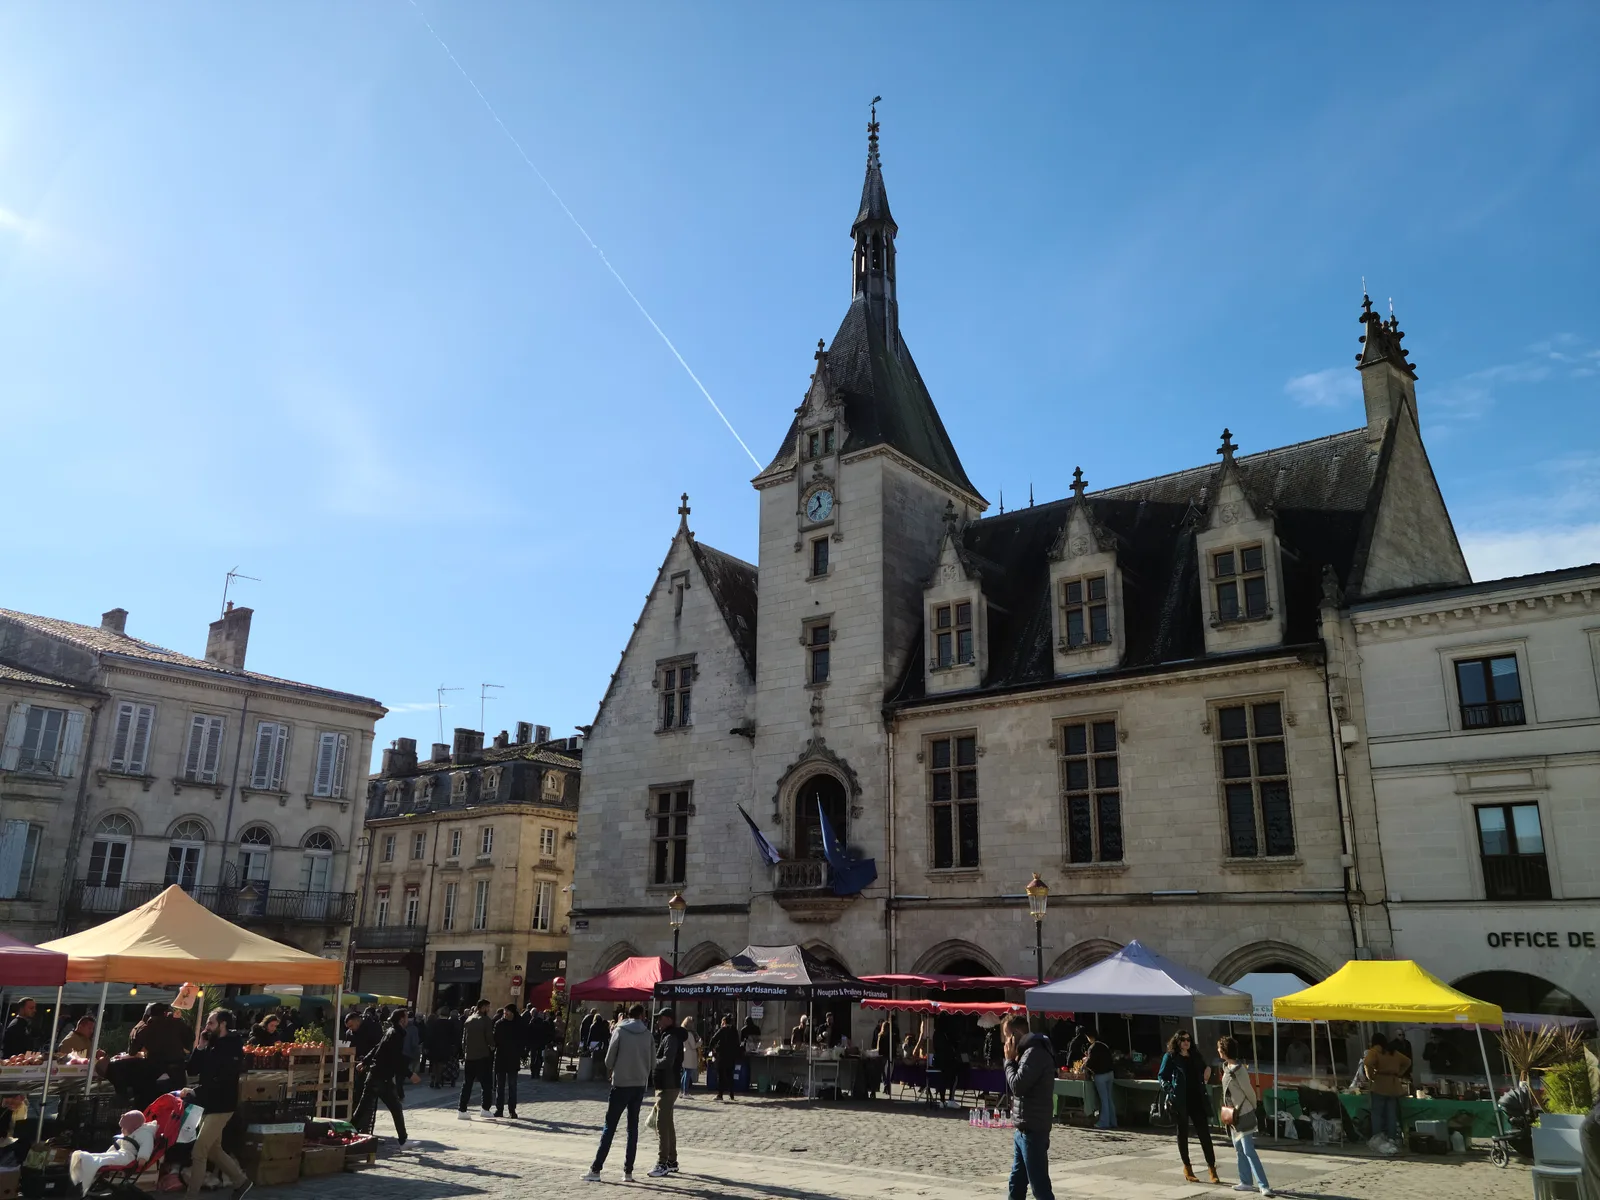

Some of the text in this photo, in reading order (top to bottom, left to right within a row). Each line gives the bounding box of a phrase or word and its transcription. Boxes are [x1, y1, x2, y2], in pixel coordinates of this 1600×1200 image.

[1487, 931, 1596, 949] OFFICE DE
[674, 985, 787, 996] Nougats & Pralines Artisanales
[817, 988, 839, 998] Nougats
[844, 988, 862, 997] Pralines
[862, 989, 888, 998] Artisanales
